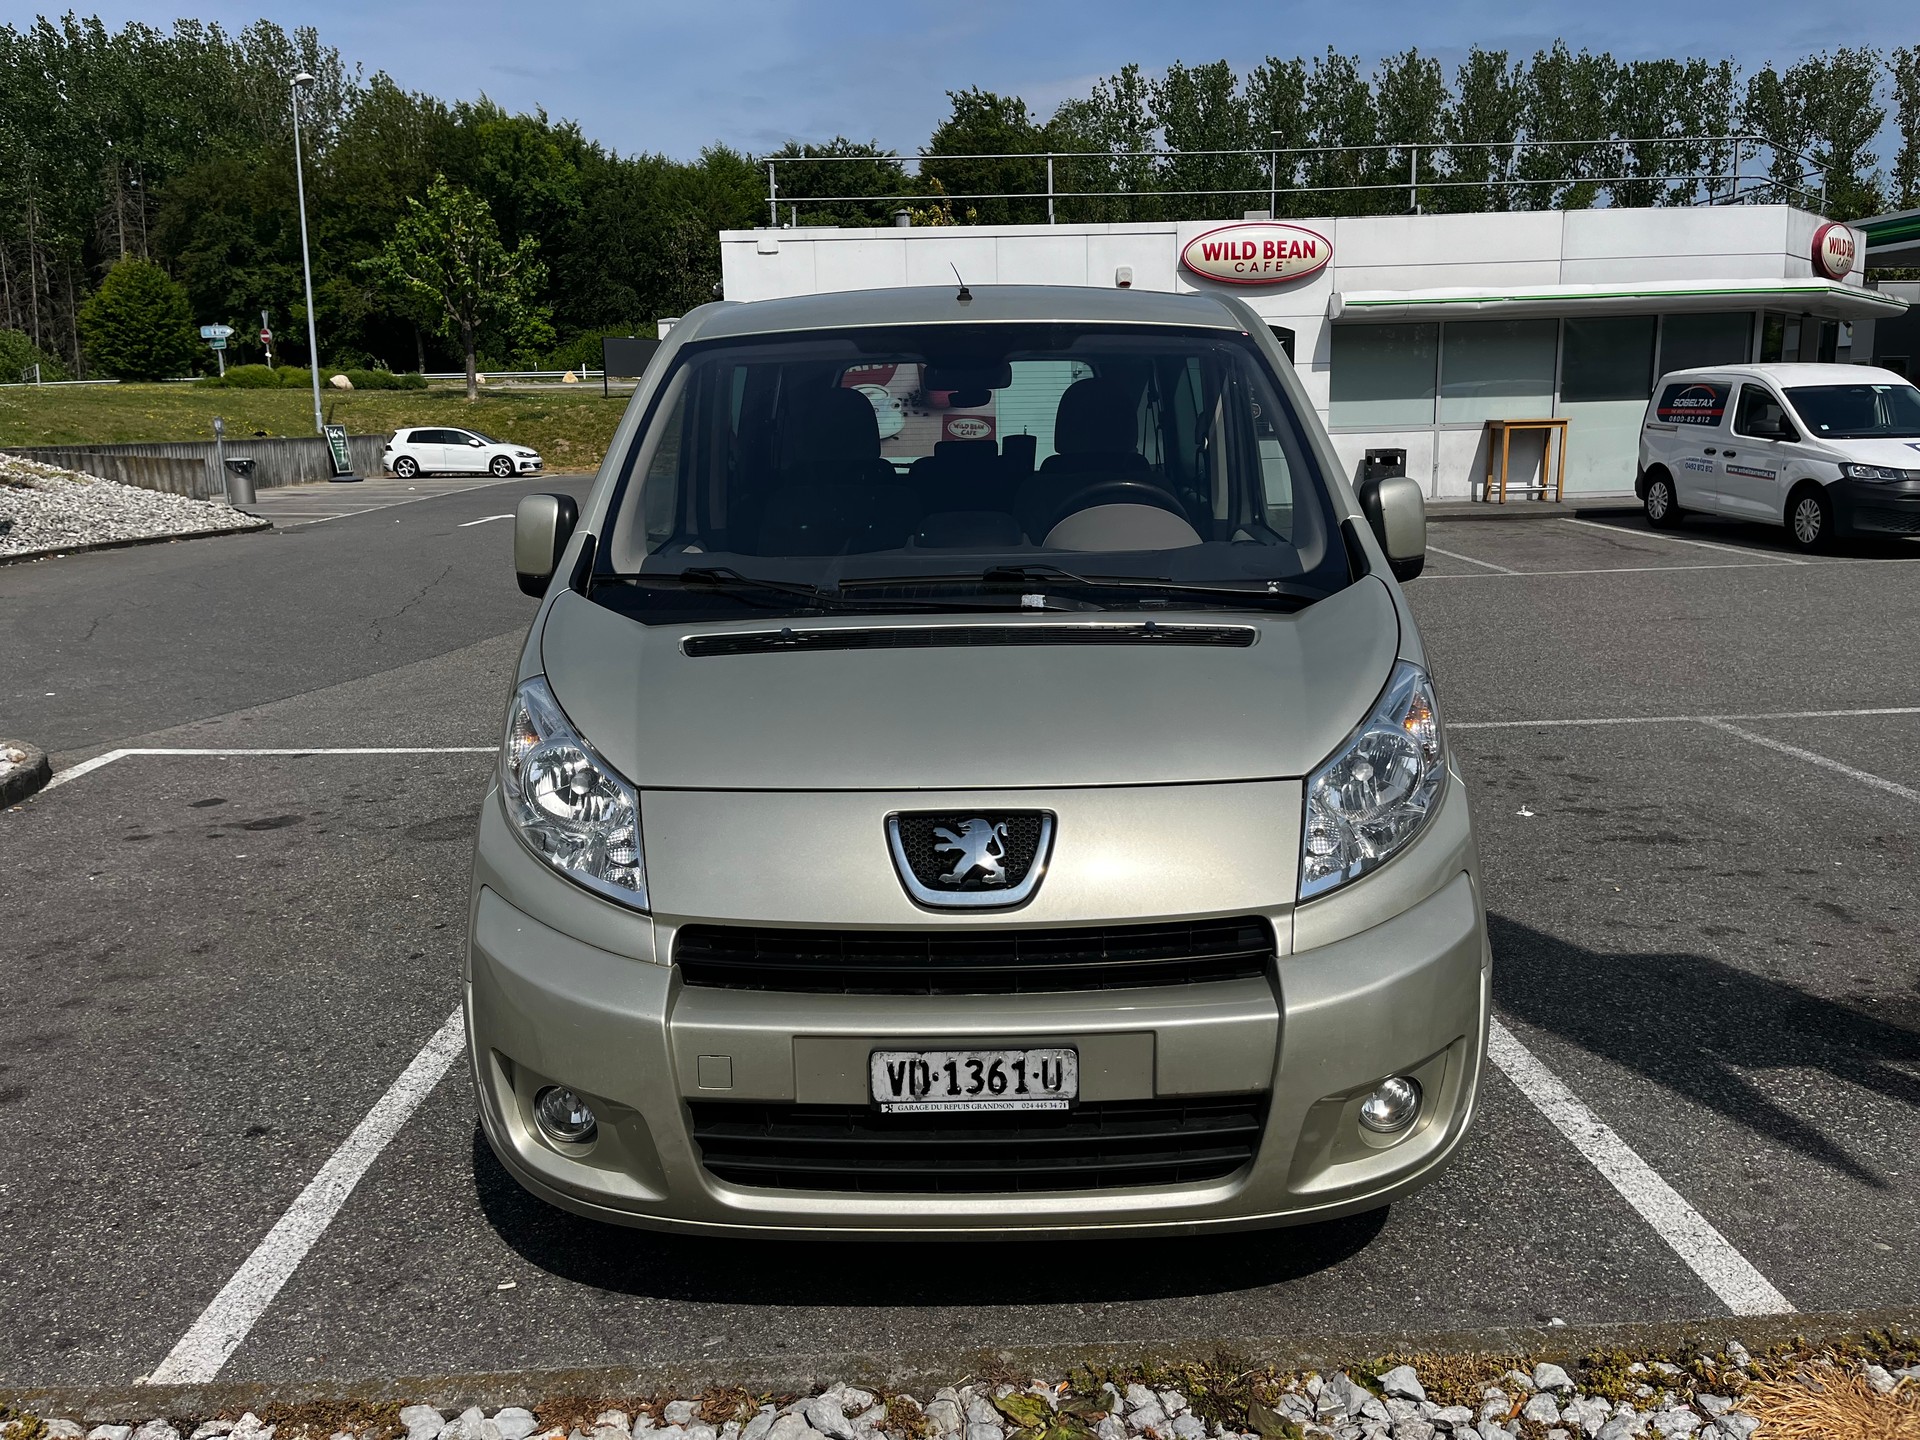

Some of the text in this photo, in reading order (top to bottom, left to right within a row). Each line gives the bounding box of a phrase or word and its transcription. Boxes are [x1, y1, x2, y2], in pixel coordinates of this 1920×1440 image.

[1201, 240, 1316, 261] WILD BEAN
[1828, 236, 1847, 257] WILD
[1672, 398, 1715, 407] SOBELTAX
[897, 1103, 930, 1112] GARAGE
[930, 1103, 943, 1111] DU
[944, 1103, 970, 1111] REPUIS
[971, 1102, 1015, 1110] GRANDSON
